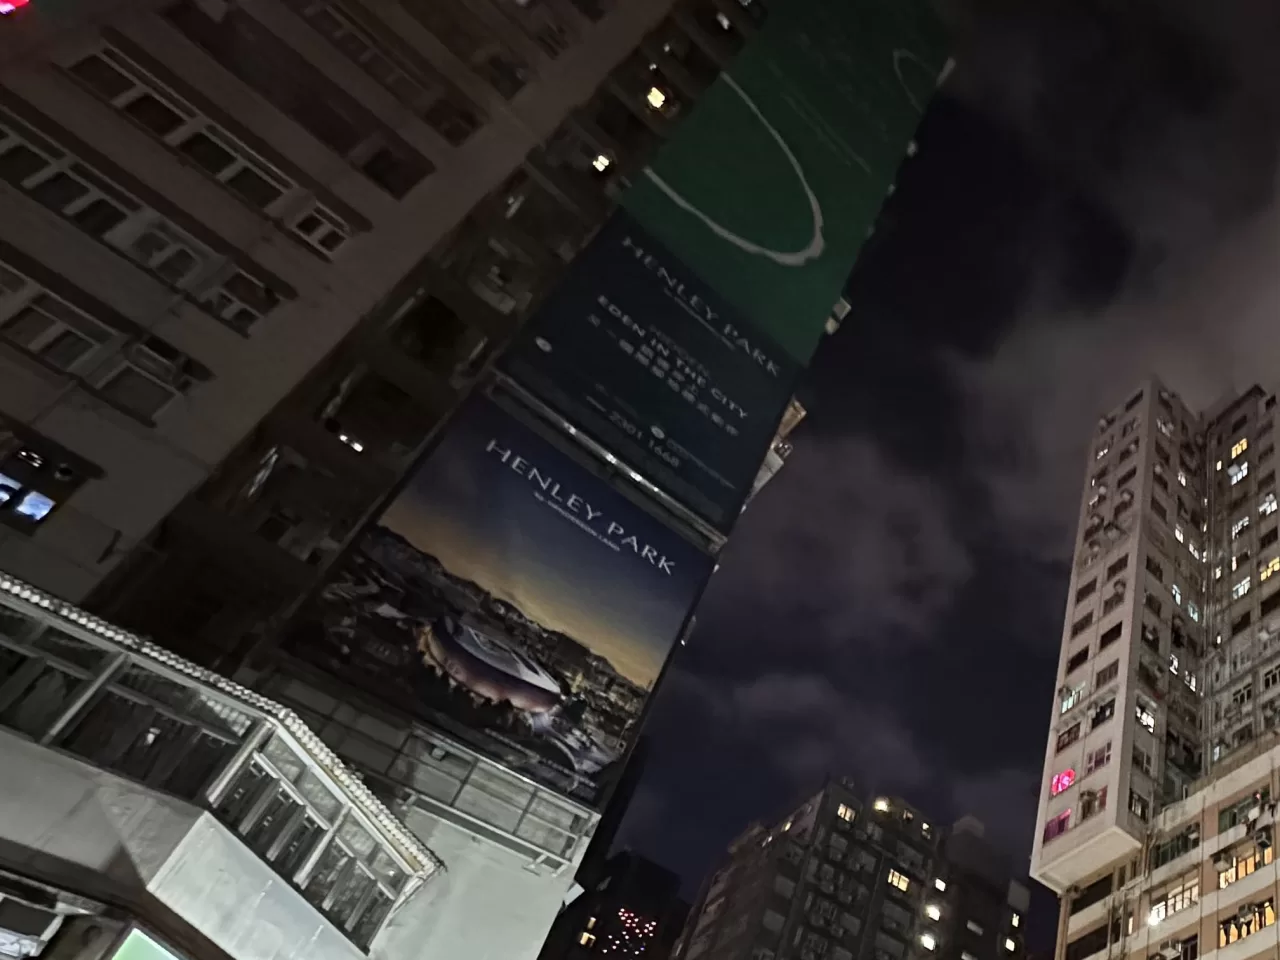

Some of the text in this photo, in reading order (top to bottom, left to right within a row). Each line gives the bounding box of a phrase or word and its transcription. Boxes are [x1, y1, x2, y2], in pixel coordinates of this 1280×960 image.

[621, 235, 719, 328] HENLEY
[724, 321, 782, 379] PARK
[709, 382, 750, 421] CITY
[485, 438, 678, 577] HENLEY PARK
